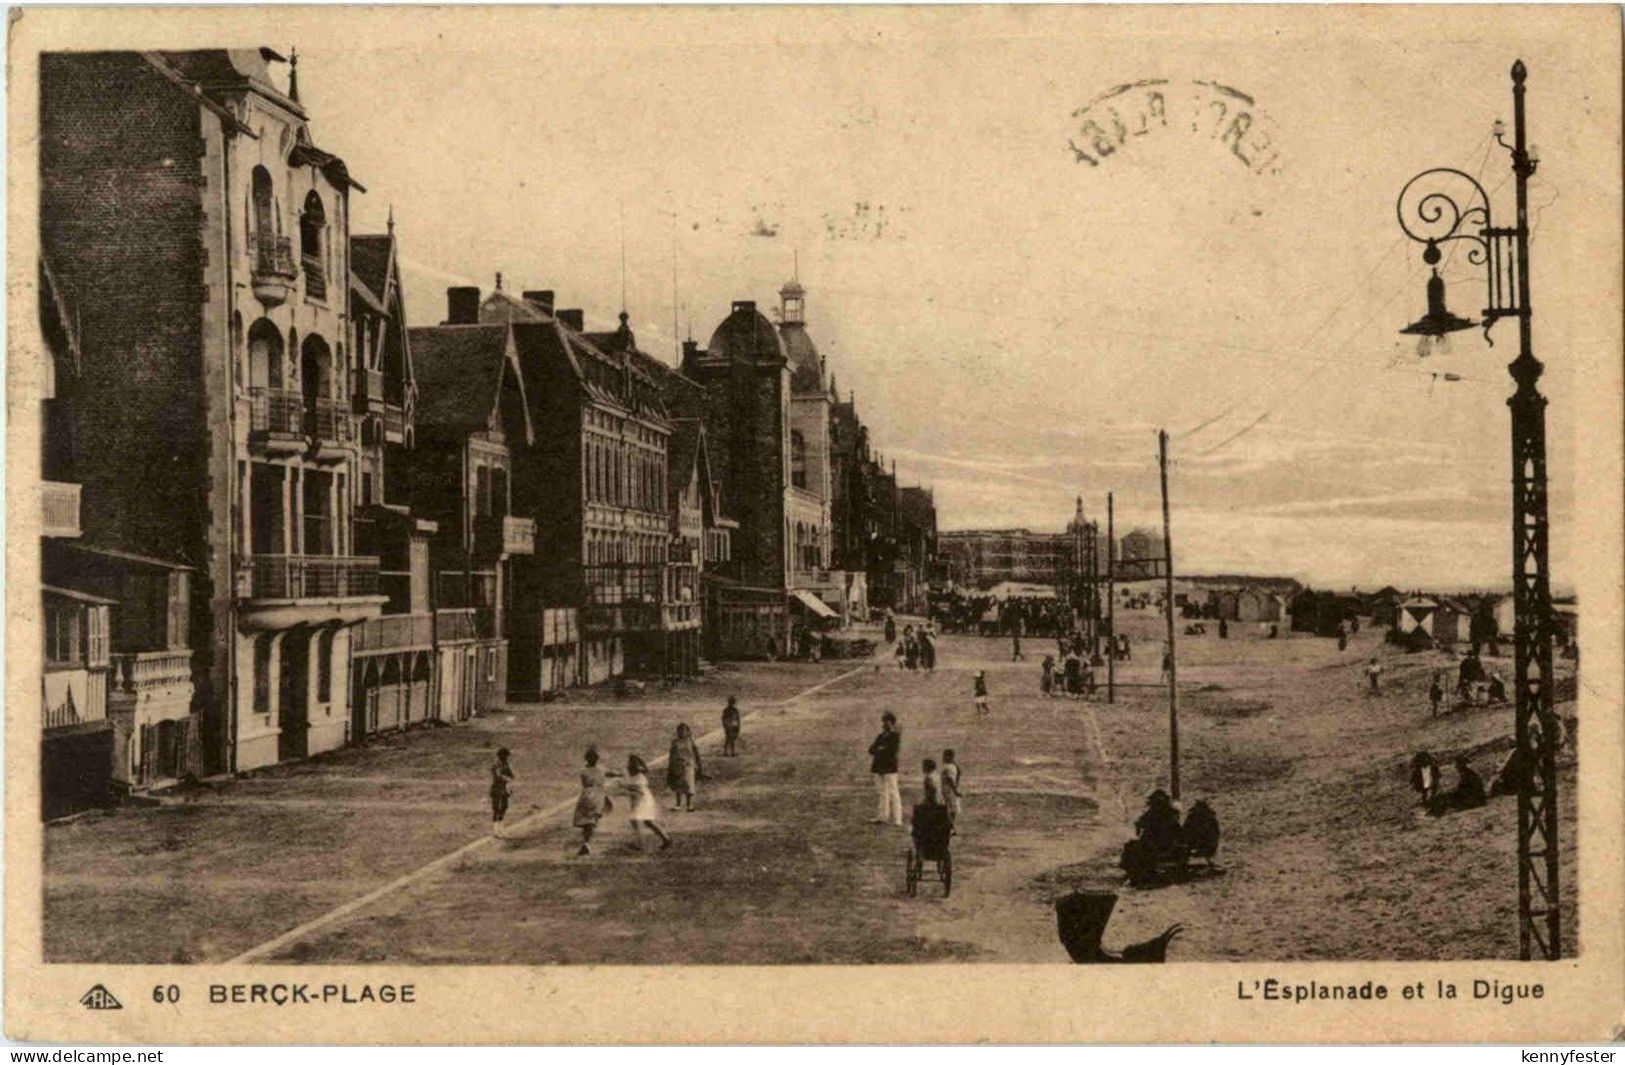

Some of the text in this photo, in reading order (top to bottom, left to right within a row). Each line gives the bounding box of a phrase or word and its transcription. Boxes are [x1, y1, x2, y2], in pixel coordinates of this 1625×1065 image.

[152, 984, 181, 1003] 60
[1402, 981, 1425, 1000] et
[1438, 979, 1457, 1000] la
[1474, 979, 1545, 1005] Digue
